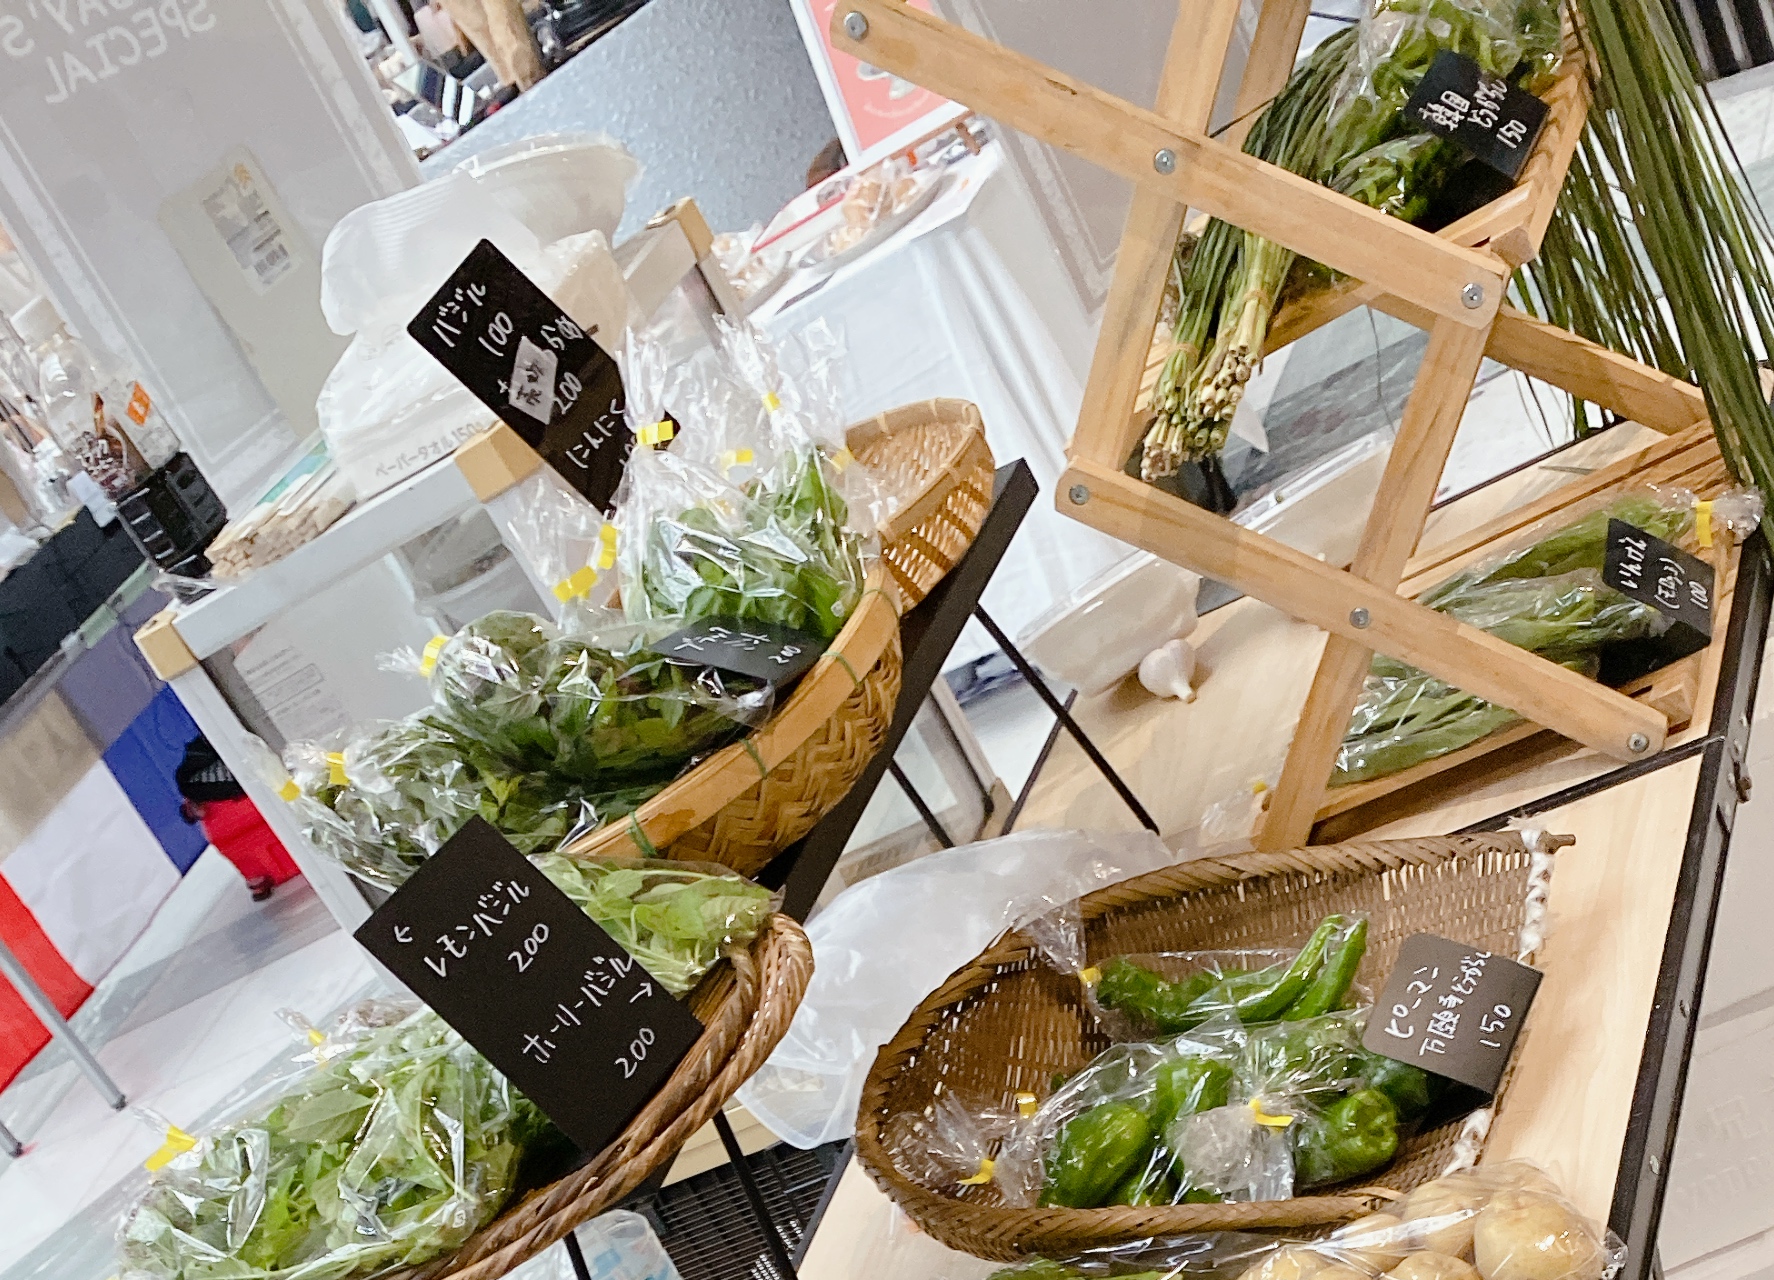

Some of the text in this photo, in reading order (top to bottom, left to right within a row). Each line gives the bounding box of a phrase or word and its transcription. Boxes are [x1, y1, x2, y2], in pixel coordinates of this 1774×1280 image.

[1496, 119, 1528, 149] 150
[432, 283, 486, 347] バジル
[478, 311, 514, 357] 100
[553, 371, 583, 415] 200
[565, 398, 626, 470] にんにく
[1618, 536, 1647, 589] いんげん
[1688, 581, 1709, 609] 100
[768, 645, 801, 664] 200
[423, 880, 530, 978] レモンバジル
[507, 922, 550, 973] 200
[522, 954, 634, 1065] ホーリーバジル
[1384, 966, 1439, 1039] ピーマン
[1479, 1004, 1512, 1048] 150
[614, 1027, 655, 1079] 200
